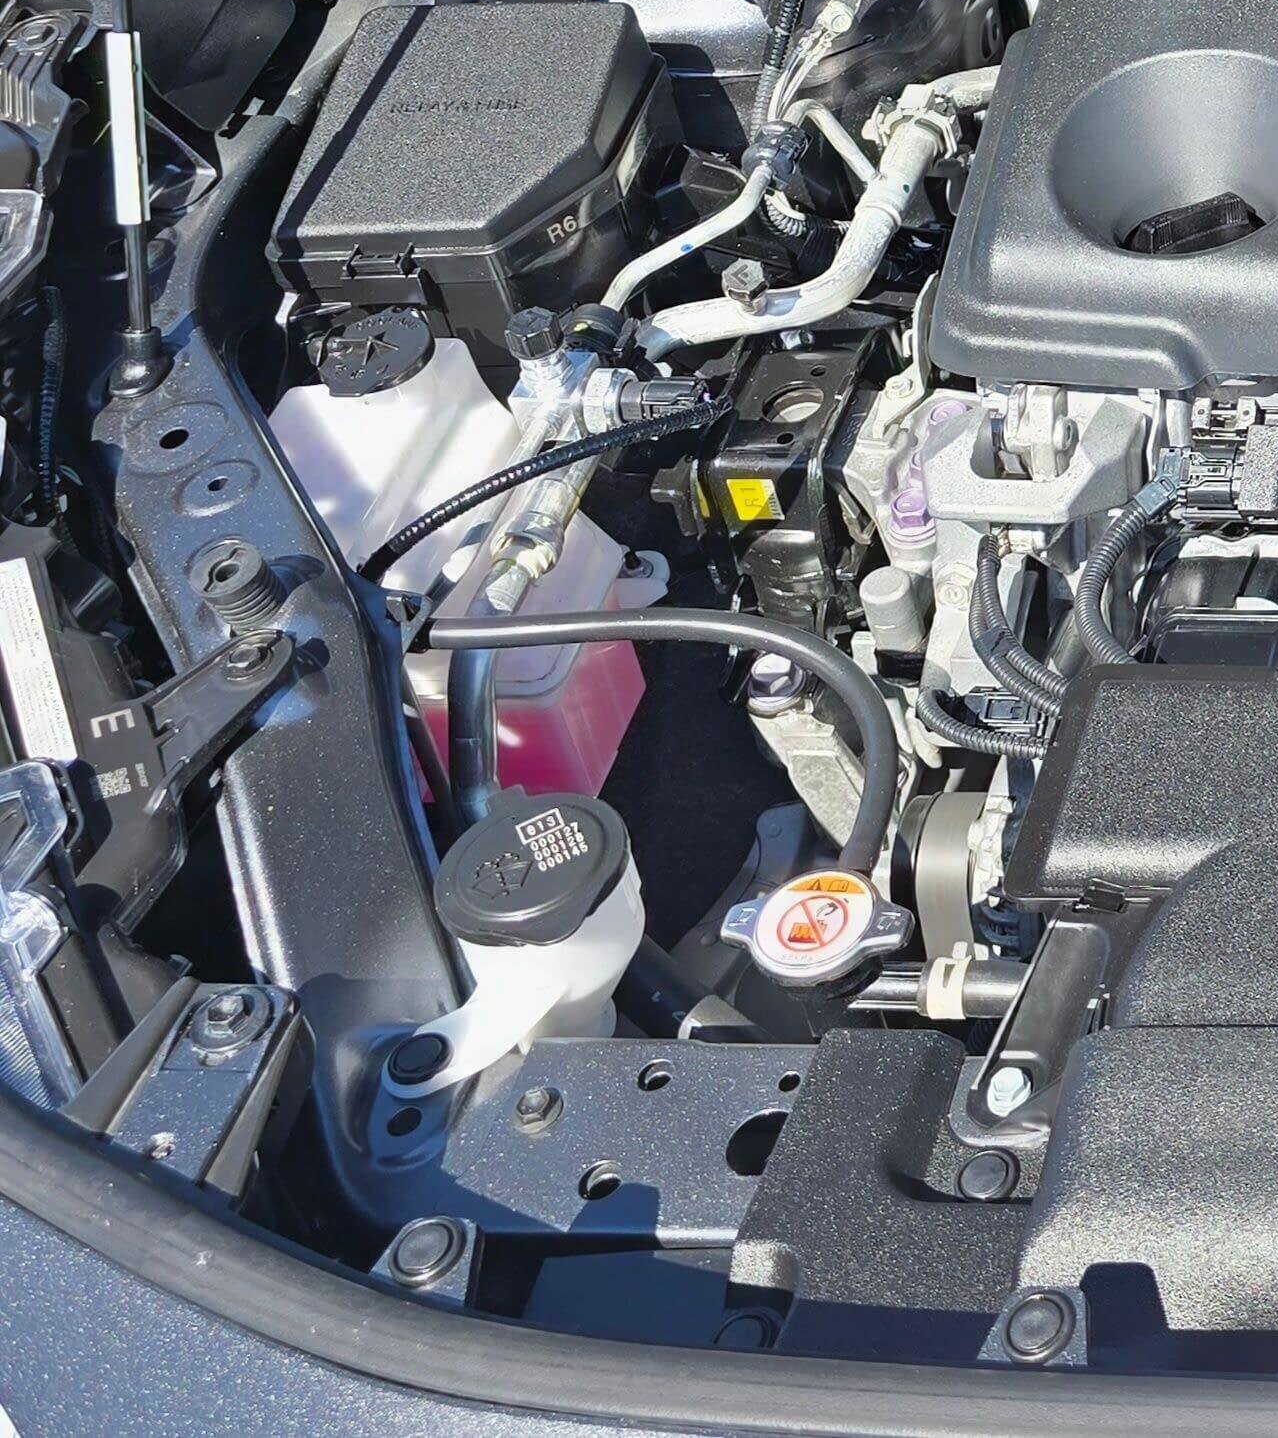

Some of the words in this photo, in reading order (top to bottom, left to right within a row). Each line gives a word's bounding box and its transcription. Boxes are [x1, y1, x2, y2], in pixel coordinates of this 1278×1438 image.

[546, 215, 577, 244] R6
[90, 707, 135, 739] E
[530, 821, 580, 852] 000127
[534, 832, 584, 862] 000128
[538, 843, 589, 872] 000145
